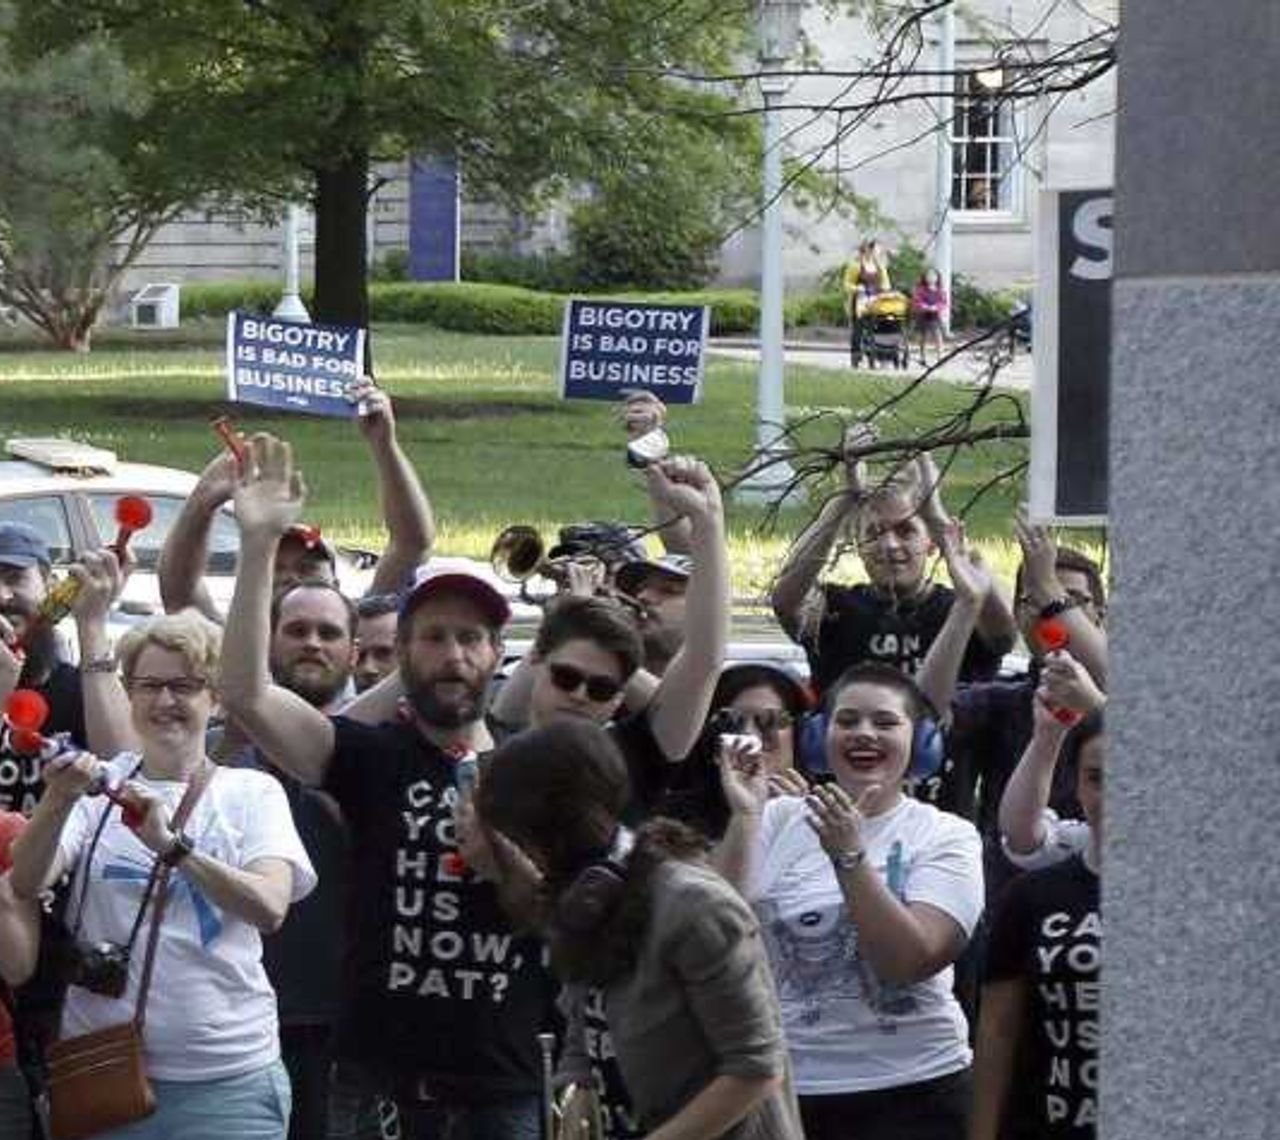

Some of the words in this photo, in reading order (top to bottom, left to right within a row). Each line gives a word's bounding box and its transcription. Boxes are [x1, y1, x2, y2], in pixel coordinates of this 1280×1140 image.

[579, 306, 694, 331] BIGOTRY
[242, 320, 349, 351] BIGOTRY
[572, 334, 592, 350] IS
[600, 335, 647, 353] BAD
[654, 337, 700, 357] FOR
[237, 345, 257, 362] IS
[262, 348, 307, 368] BAD
[312, 356, 356, 376] FOR
[569, 360, 700, 386] BUSINESS
[395, 885, 460, 921] US
[392, 924, 523, 970] NOW,
[387, 961, 509, 1003] PAT?
